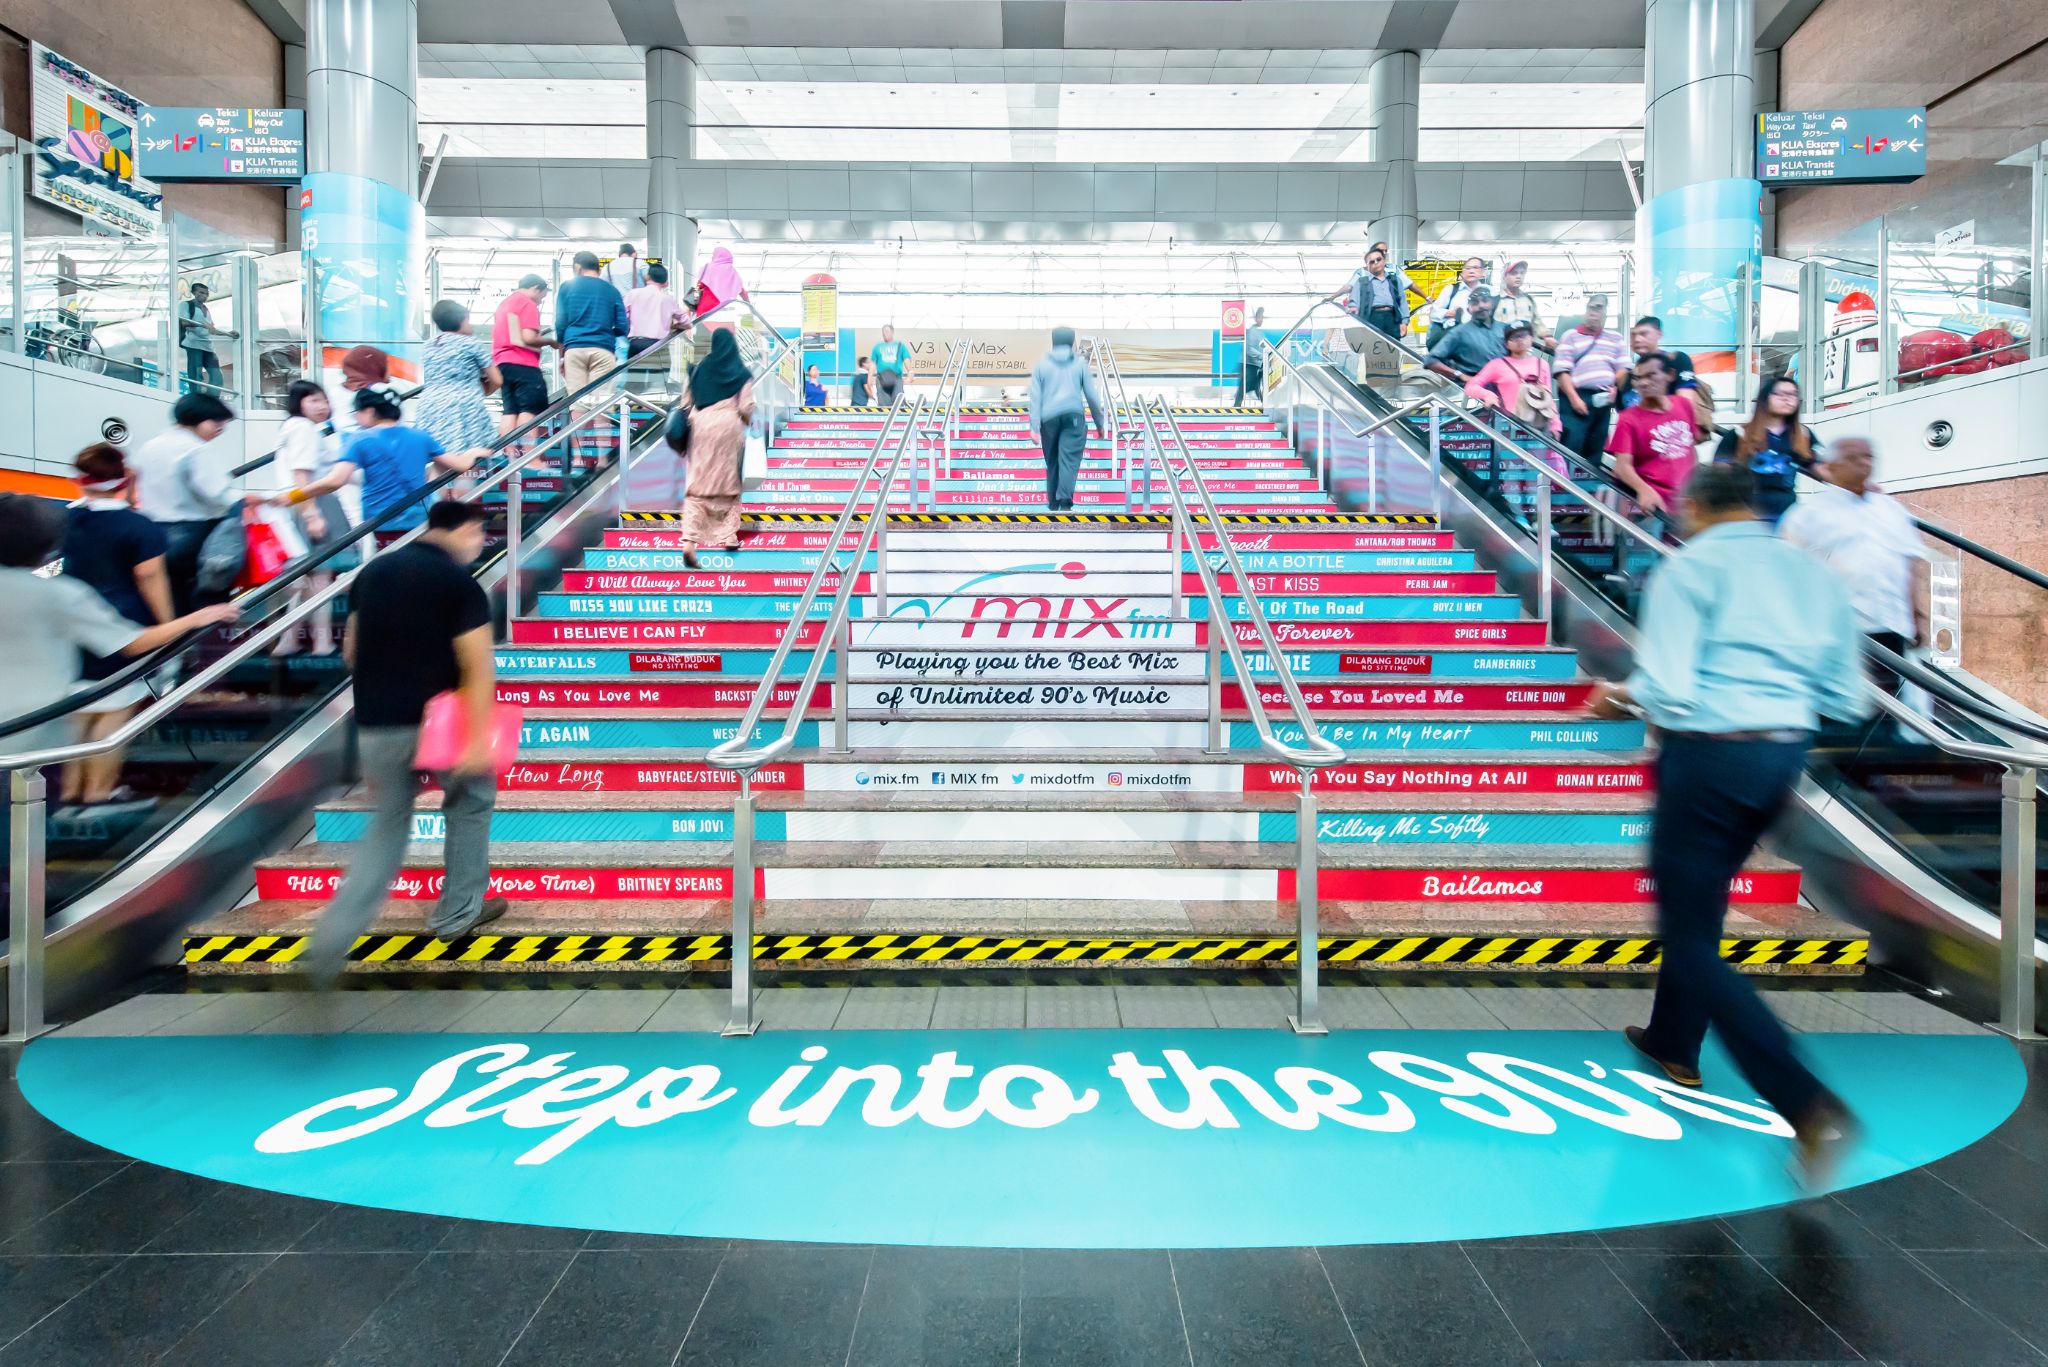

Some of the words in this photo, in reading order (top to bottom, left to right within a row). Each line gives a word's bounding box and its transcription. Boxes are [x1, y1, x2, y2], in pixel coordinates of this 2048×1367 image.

[216, 108, 239, 117] Teksi
[254, 109, 284, 118] Keluar
[1766, 113, 1796, 122] Keluar
[1802, 112, 1825, 120] Teksi
[254, 119, 270, 127] Way
[1766, 123, 1782, 131] Way
[245, 137, 268, 146] KLIA
[269, 137, 303, 147] Ekspres
[1781, 141, 1804, 149] KLIA
[1806, 140, 1840, 150] Ekspres
[246, 158, 268, 166] KLIA
[268, 158, 298, 166] Transit
[1781, 161, 1804, 169] KLIA
[1805, 161, 1835, 169] Transit
[971, 342, 1007, 355] Max
[963, 471, 1015, 479] Bailamos
[952, 495, 994, 503] Killing
[619, 536, 649, 547] When
[653, 536, 674, 548] You
[749, 535, 764, 546] At
[768, 535, 786, 546] All
[803, 536, 828, 545] RONAN
[1355, 537, 1406, 546] SANTANA/ROB
[1407, 537, 1437, 546] THOMAS
[607, 555, 650, 568] BACK
[653, 555, 685, 568] FOR
[1249, 556, 1264, 568] IN
[1267, 556, 1279, 568] A
[1283, 555, 1345, 568] BOTTLE
[1376, 557, 1415, 566] CHRISTINA
[1417, 557, 1453, 566] AGUILERA
[597, 576, 629, 589] Will
[631, 575, 680, 592] Always
[684, 575, 716, 588] Love
[718, 575, 747, 593] You
[774, 577, 808, 587] WHITNEY
[1284, 577, 1320, 591] KISS
[1406, 579, 1431, 589] PEARL
[1432, 579, 1448, 589] JAM
[570, 599, 605, 612] MISS
[609, 599, 633, 612] YOU
[638, 599, 668, 612] LIKE
[672, 599, 713, 613] CRAZY
[775, 601, 790, 611] THE
[1270, 601, 1287, 615] Of
[1293, 601, 1320, 615] The
[1326, 601, 1364, 615] Road
[1433, 602, 1454, 612] BOYZ
[1464, 602, 1483, 612] MEN
[1127, 608, 1173, 639] fm
[553, 627, 559, 639] I
[564, 626, 629, 639] BELIEVE
[633, 627, 638, 639] I
[643, 626, 676, 639] CAN
[680, 625, 707, 639] FLY
[1275, 624, 1354, 642] Forever
[1455, 628, 1482, 639] SPICE
[1483, 628, 1507, 639] GIRLS
[494, 656, 597, 669] WATERFALLS
[635, 655, 681, 664] DILARANG
[683, 655, 716, 664] DUDUK
[876, 651, 970, 676] Playing
[974, 656, 1019, 677] you
[1025, 651, 1061, 670] the
[1067, 651, 1122, 671] Best
[1127, 651, 1180, 671] Mix
[1346, 656, 1393, 666] DILARANG
[1394, 655, 1427, 666] DUDUK
[1473, 658, 1537, 670] CRANBERRIES
[497, 689, 530, 704] Long
[538, 689, 556, 702] As
[563, 689, 590, 702] You
[598, 689, 632, 702] Love
[639, 689, 660, 702] Me
[876, 686, 904, 710] of
[909, 686, 1034, 705] Unlimited
[1040, 685, 1088, 705] 90's
[1092, 685, 1170, 705] Music
[1330, 689, 1364, 704] You
[1370, 688, 1427, 704] Loved
[1434, 689, 1464, 704] Me
[1506, 691, 1538, 703] CELINE
[1542, 691, 1566, 703] DION
[539, 726, 590, 742] AGAIN
[1333, 727, 1354, 742] Be
[1360, 727, 1378, 741] In
[1387, 727, 1412, 747] My
[1421, 726, 1473, 742] Heart
[1530, 731, 1554, 743] PHIL
[1556, 731, 1599, 743] COLLINS
[505, 766, 549, 787] How
[558, 764, 604, 790] Long
[638, 771, 737, 783] BABYFACE/STEVIE
[873, 772, 919, 785] mix.fm
[951, 773, 977, 785] MIX
[981, 772, 999, 785] fm
[1030, 772, 1095, 785] mixdotfm
[1127, 772, 1192, 785] mixdotfm
[1326, 770, 1357, 785] You
[1363, 770, 1396, 787] Say
[1402, 770, 1473, 788] Nothing
[1478, 770, 1497, 785] At
[1503, 770, 1527, 785] All
[1557, 774, 1595, 786] RONAN
[1597, 774, 1644, 787] KEATING
[672, 820, 696, 832] BON
[699, 820, 724, 832] JOVI
[1318, 819, 1386, 842] Killing
[1389, 818, 1422, 837] Me
[1428, 815, 1490, 839] Softly
[287, 875, 323, 892] Hit
[486, 876, 535, 891] More
[540, 875, 596, 894] Time)
[618, 877, 671, 891] BRITNEY
[675, 877, 723, 891] SPEARS
[1422, 875, 1543, 897] Bailamos
[748, 1046, 1099, 1128] into
[1108, 1049, 1416, 1133] the
[254, 1043, 738, 1166] Step
